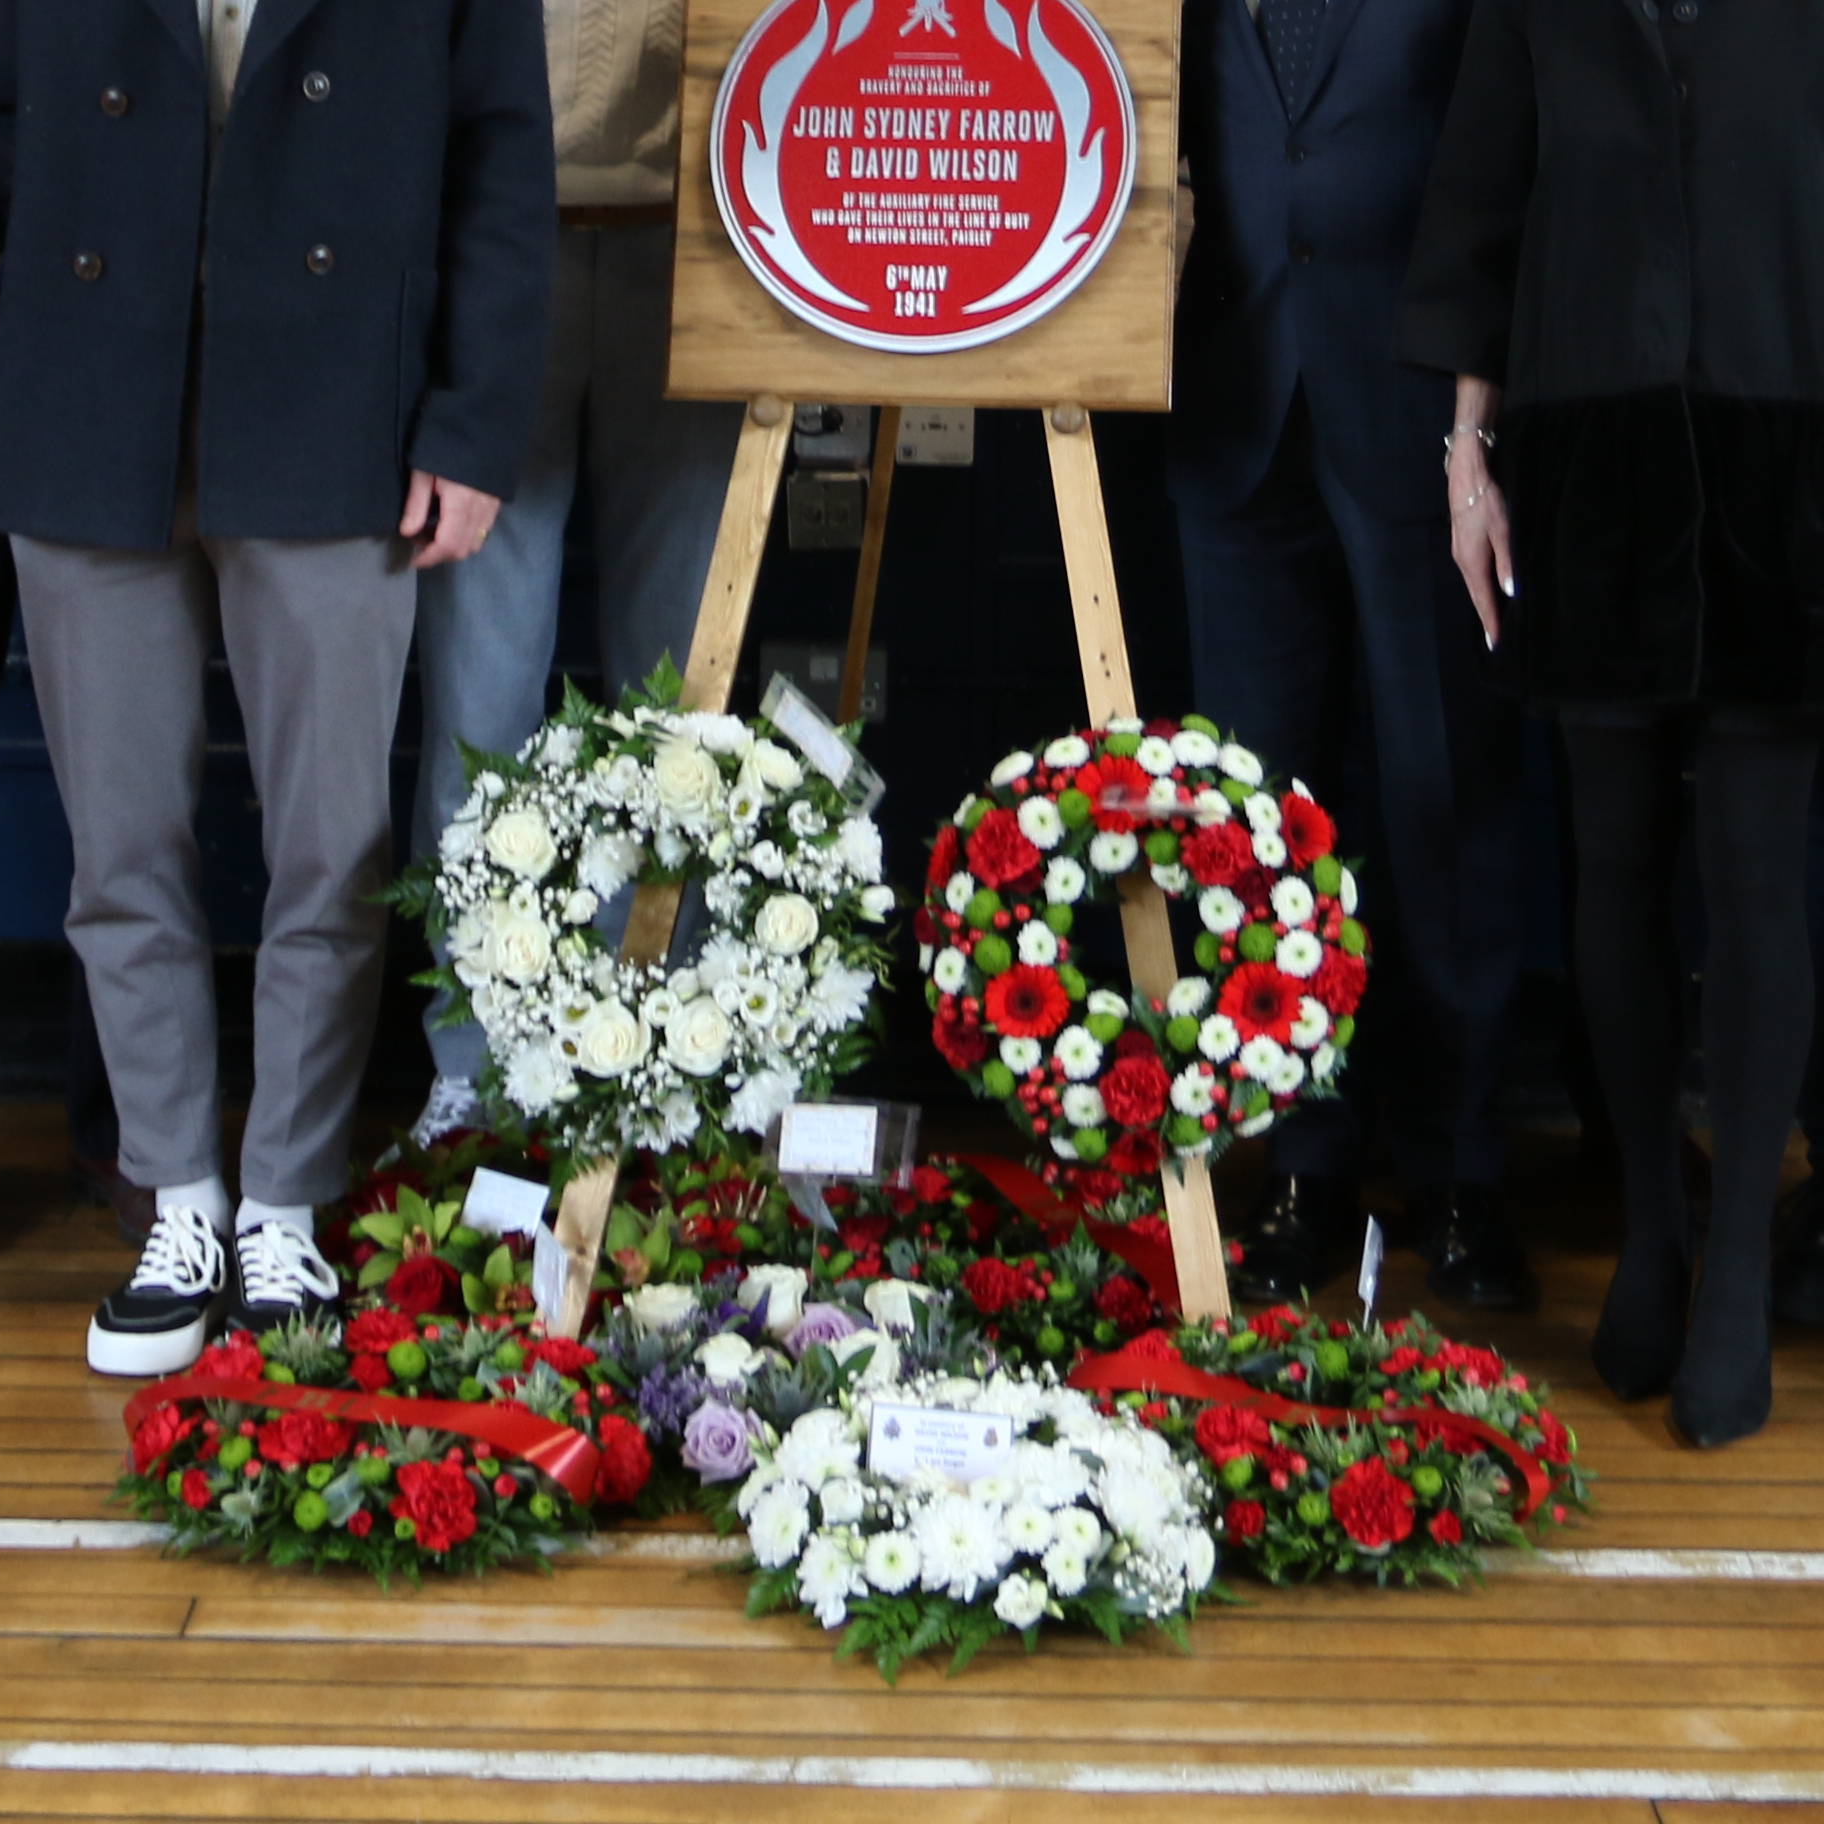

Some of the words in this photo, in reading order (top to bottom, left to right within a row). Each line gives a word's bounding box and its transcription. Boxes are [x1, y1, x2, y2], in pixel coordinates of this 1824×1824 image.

[905, 79, 923, 96] AND
[978, 80, 991, 97] OF
[792, 105, 853, 138] JOHN
[863, 106, 951, 141] SYDNEY
[959, 108, 1055, 142] FARROW
[825, 145, 841, 179] &
[850, 145, 919, 180] DAVID
[928, 147, 1019, 182] WILSON
[842, 191, 855, 209] OF
[858, 191, 876, 209] THE
[879, 192, 930, 210] AUXILIARY
[933, 193, 955, 210] FIRE
[958, 194, 1000, 211] SERVICE
[811, 208, 835, 226] WHO
[837, 209, 862, 226] GAVE
[866, 209, 894, 227] THEIR
[897, 210, 925, 227] LIVES
[928, 211, 939, 227] IN
[942, 211, 960, 228] THE
[963, 211, 986, 229] LINE
[989, 212, 1001, 230] OF
[1004, 212, 1031, 230] DUTY
[847, 226, 862, 244] ON
[864, 227, 907, 245] NEWTON
[951, 229, 993, 247] PAISLEY
[911, 265, 948, 292] MAY
[894, 291, 936, 318] 1941
